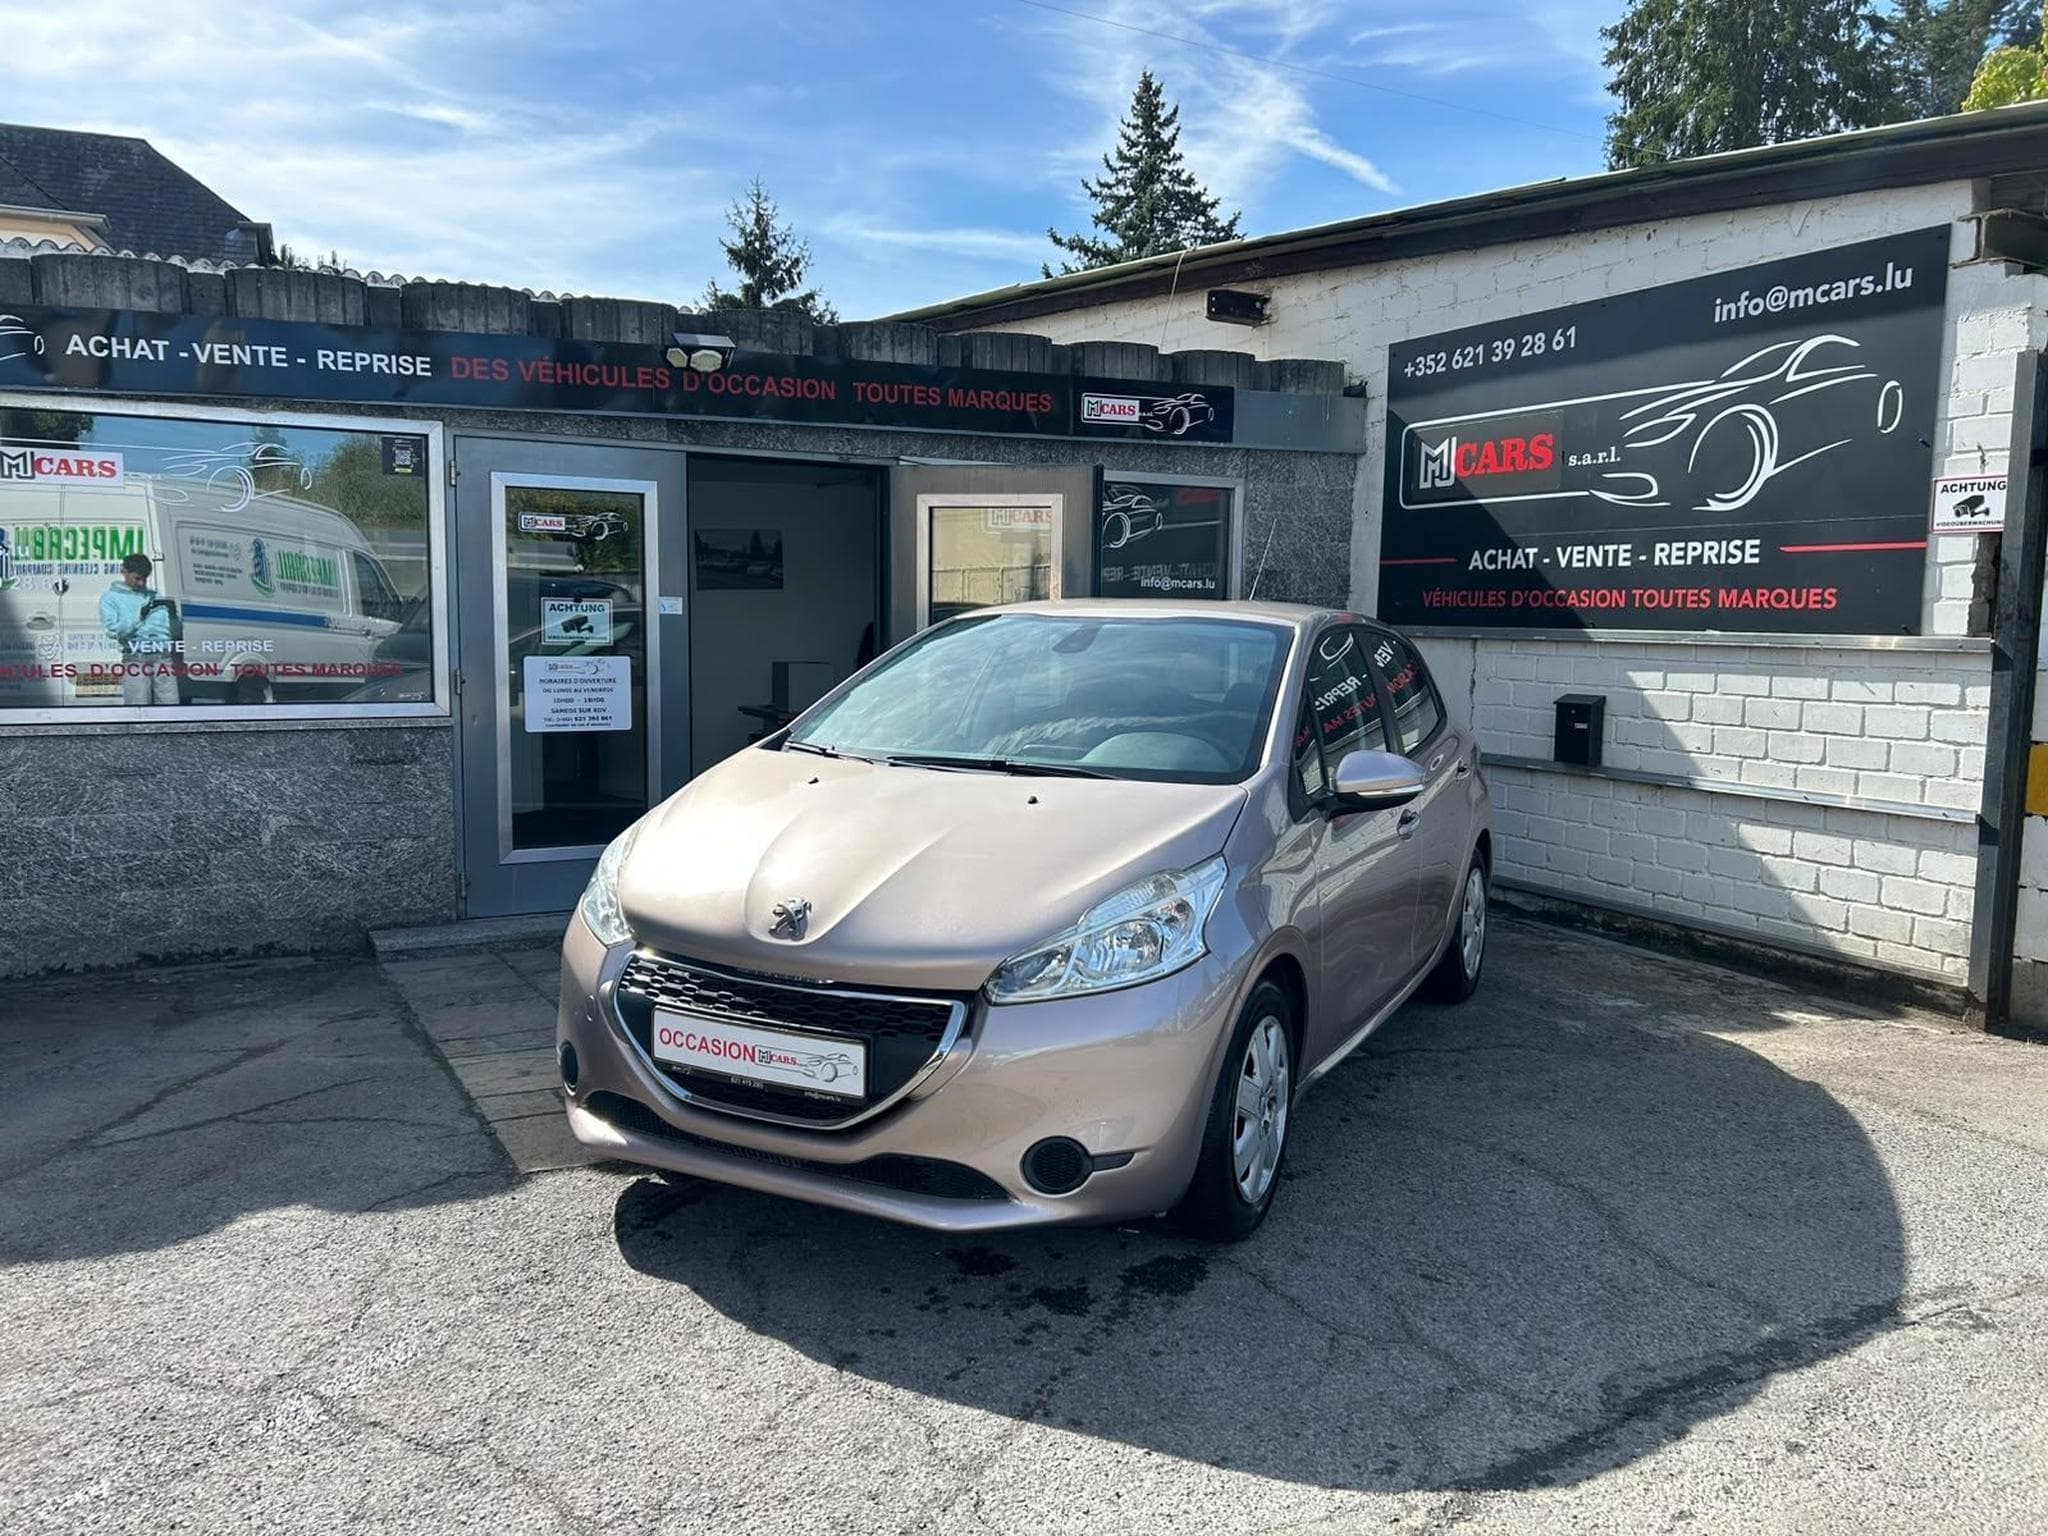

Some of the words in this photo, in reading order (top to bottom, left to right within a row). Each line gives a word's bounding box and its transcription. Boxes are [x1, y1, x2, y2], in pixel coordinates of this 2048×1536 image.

[1714, 262, 1913, 323] info@mcars.lu
[1403, 351, 1447, 378] +352
[1452, 344, 1484, 370] 621
[1491, 338, 1516, 363] 39
[1520, 332, 1546, 357] 28
[1552, 325, 1577, 351] 61
[65, 333, 170, 361] ACHAT
[316, 349, 432, 377] REPRISE
[450, 356, 510, 381] DES
[517, 355, 671, 390] VÉHICULES
[682, 370, 836, 400] D'OCCASION
[852, 381, 941, 407] TOUTES
[947, 387, 1054, 413] MARQUES
[1567, 446, 1622, 467] s.a.r.l.
[1940, 480, 2007, 494] ACHTUNG
[1468, 547, 1539, 571] ACHAT
[1555, 543, 1632, 568] VENTE
[1653, 538, 1761, 566] REPRISE
[1140, 576, 1216, 591] info@mcars.lu
[548, 603, 606, 613] ACHTUNG
[1422, 586, 1506, 608] VÉHICULES
[1512, 588, 1626, 609] D'OCCASION
[1631, 587, 1711, 609] TOUTES
[1717, 587, 1838, 610] MARQUES
[127, 640, 186, 654] VENTE
[201, 640, 274, 653] REPRISE
[90, 663, 219, 678] D'OCCASION
[230, 663, 307, 677] TOUTES
[658, 1028, 756, 1064] OCCASION
